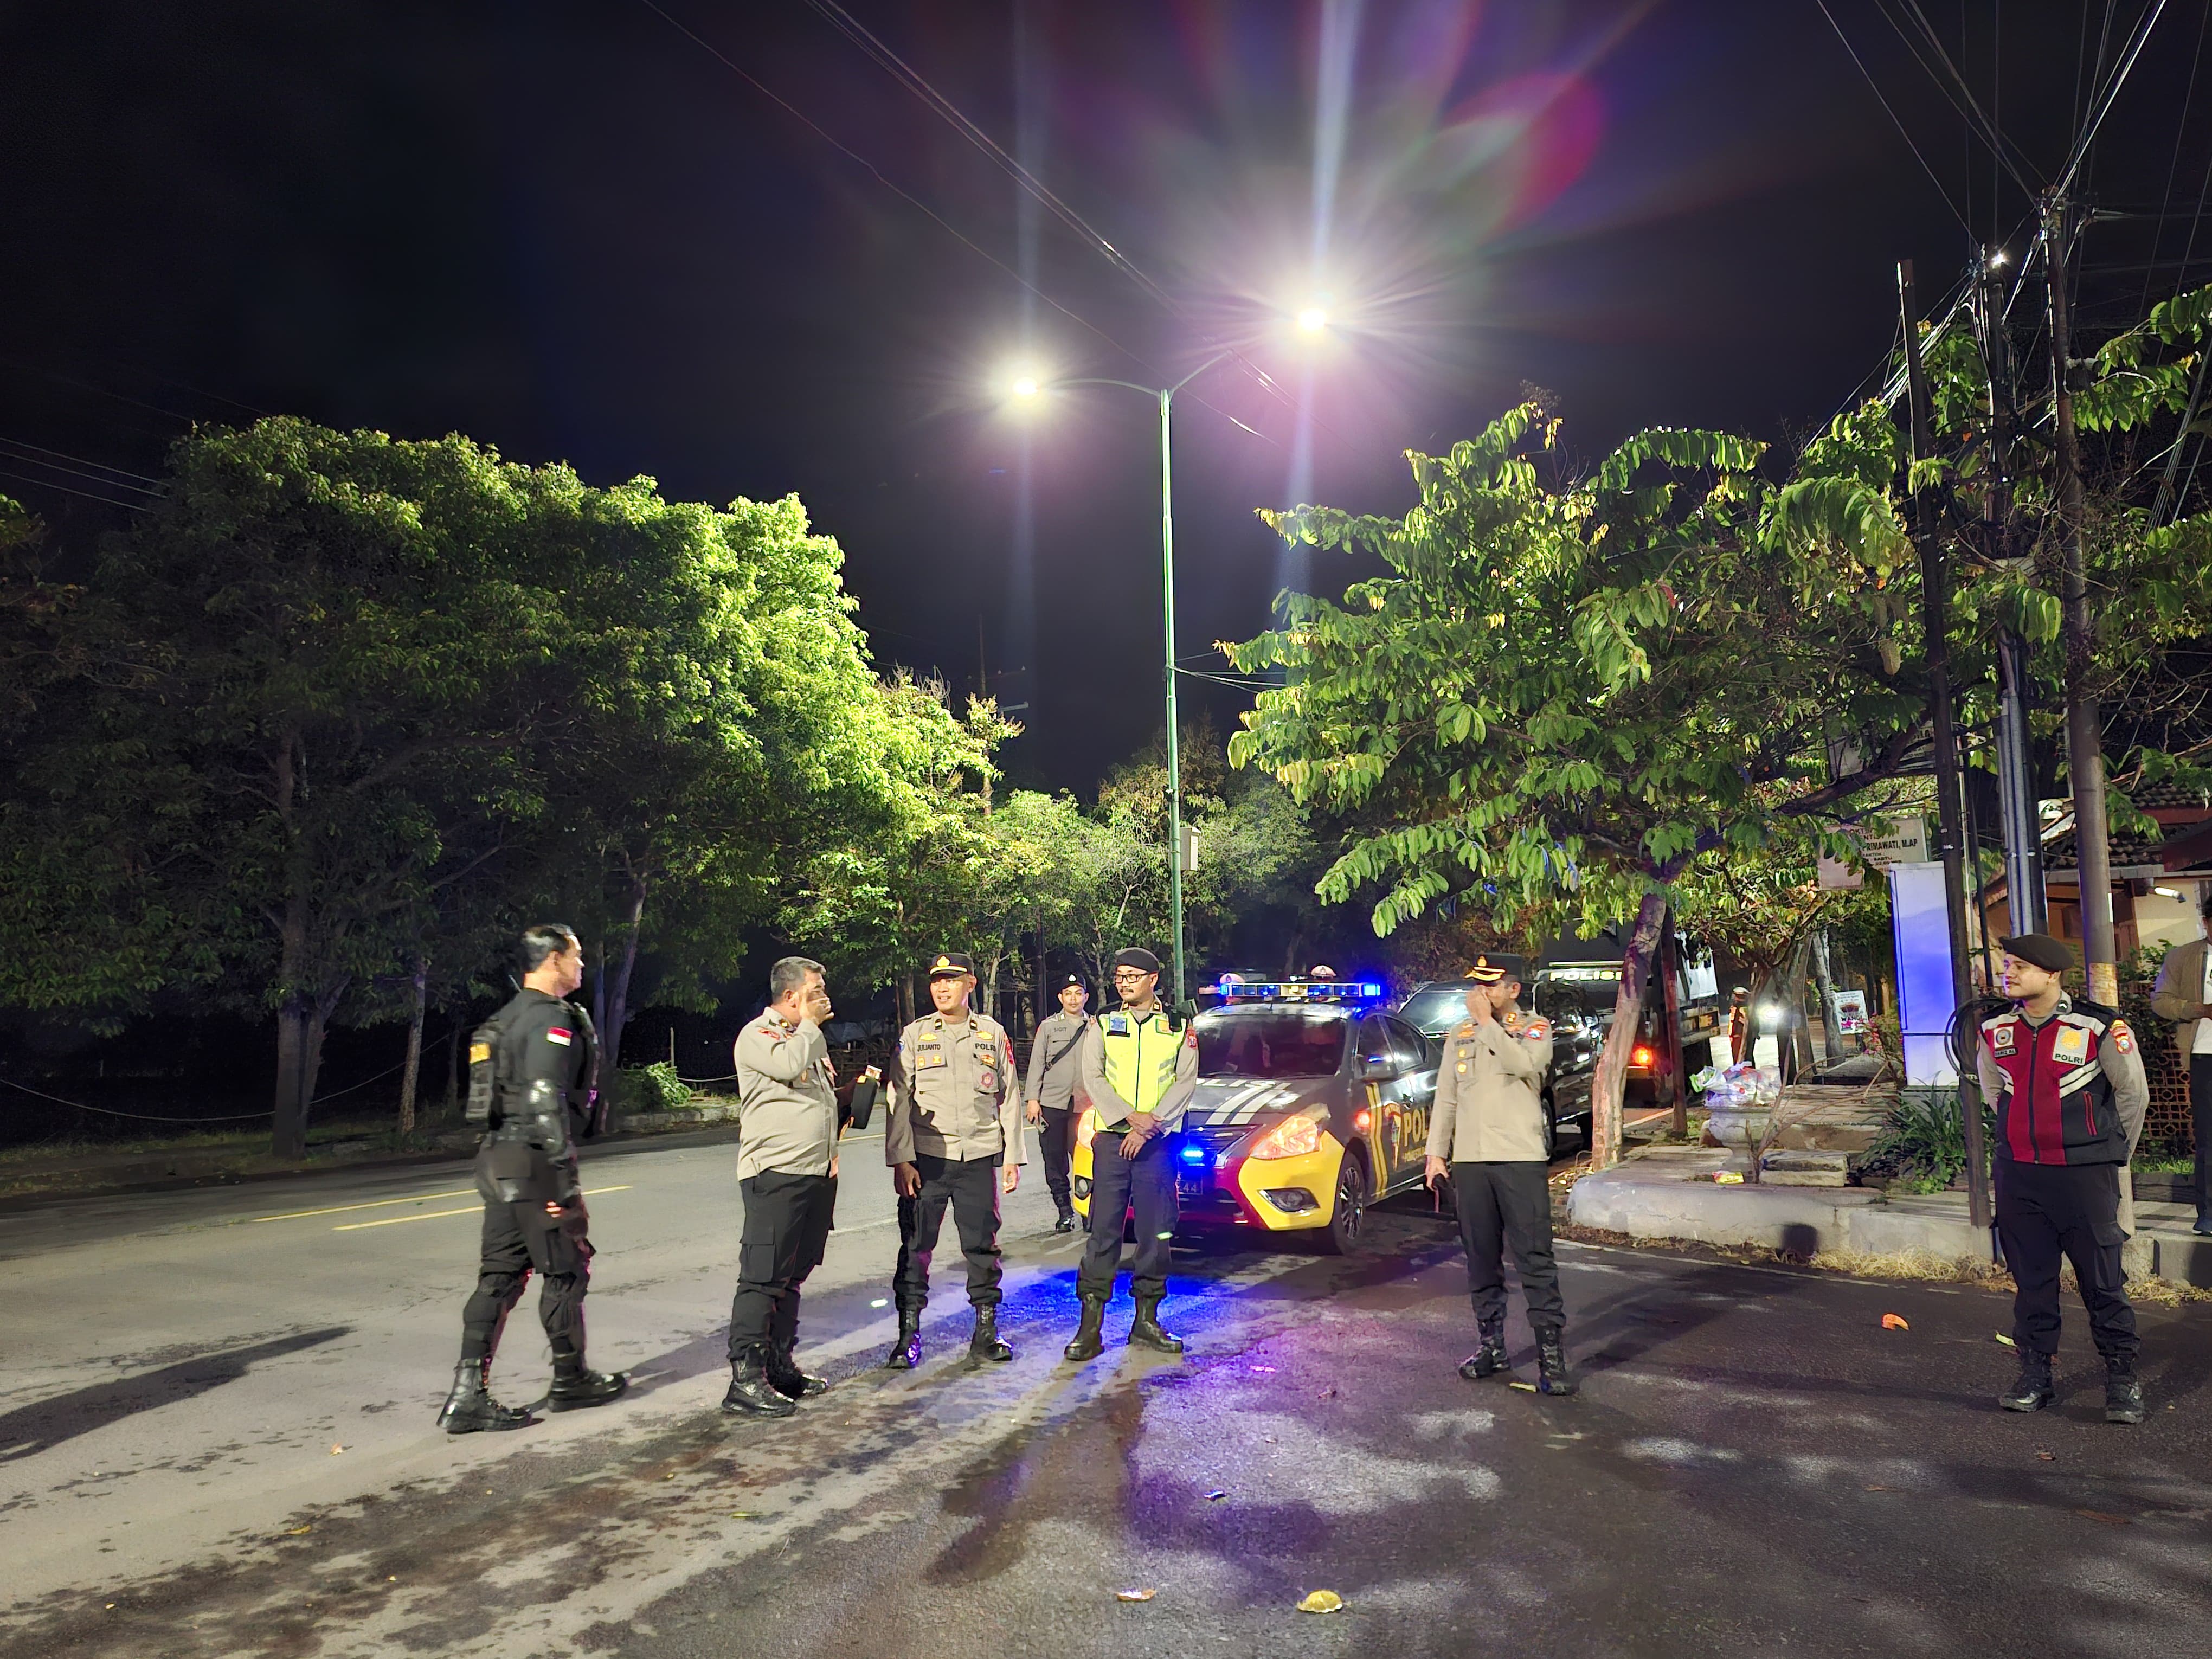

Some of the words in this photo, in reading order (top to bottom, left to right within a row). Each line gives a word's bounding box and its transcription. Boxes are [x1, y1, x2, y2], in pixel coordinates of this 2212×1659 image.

[1549, 970, 1623, 982] POLISI
[917, 1044, 941, 1052] JULIANTO
[2055, 1053, 2084, 1064] POLRI
[1196, 1078, 1293, 1090] LISI
